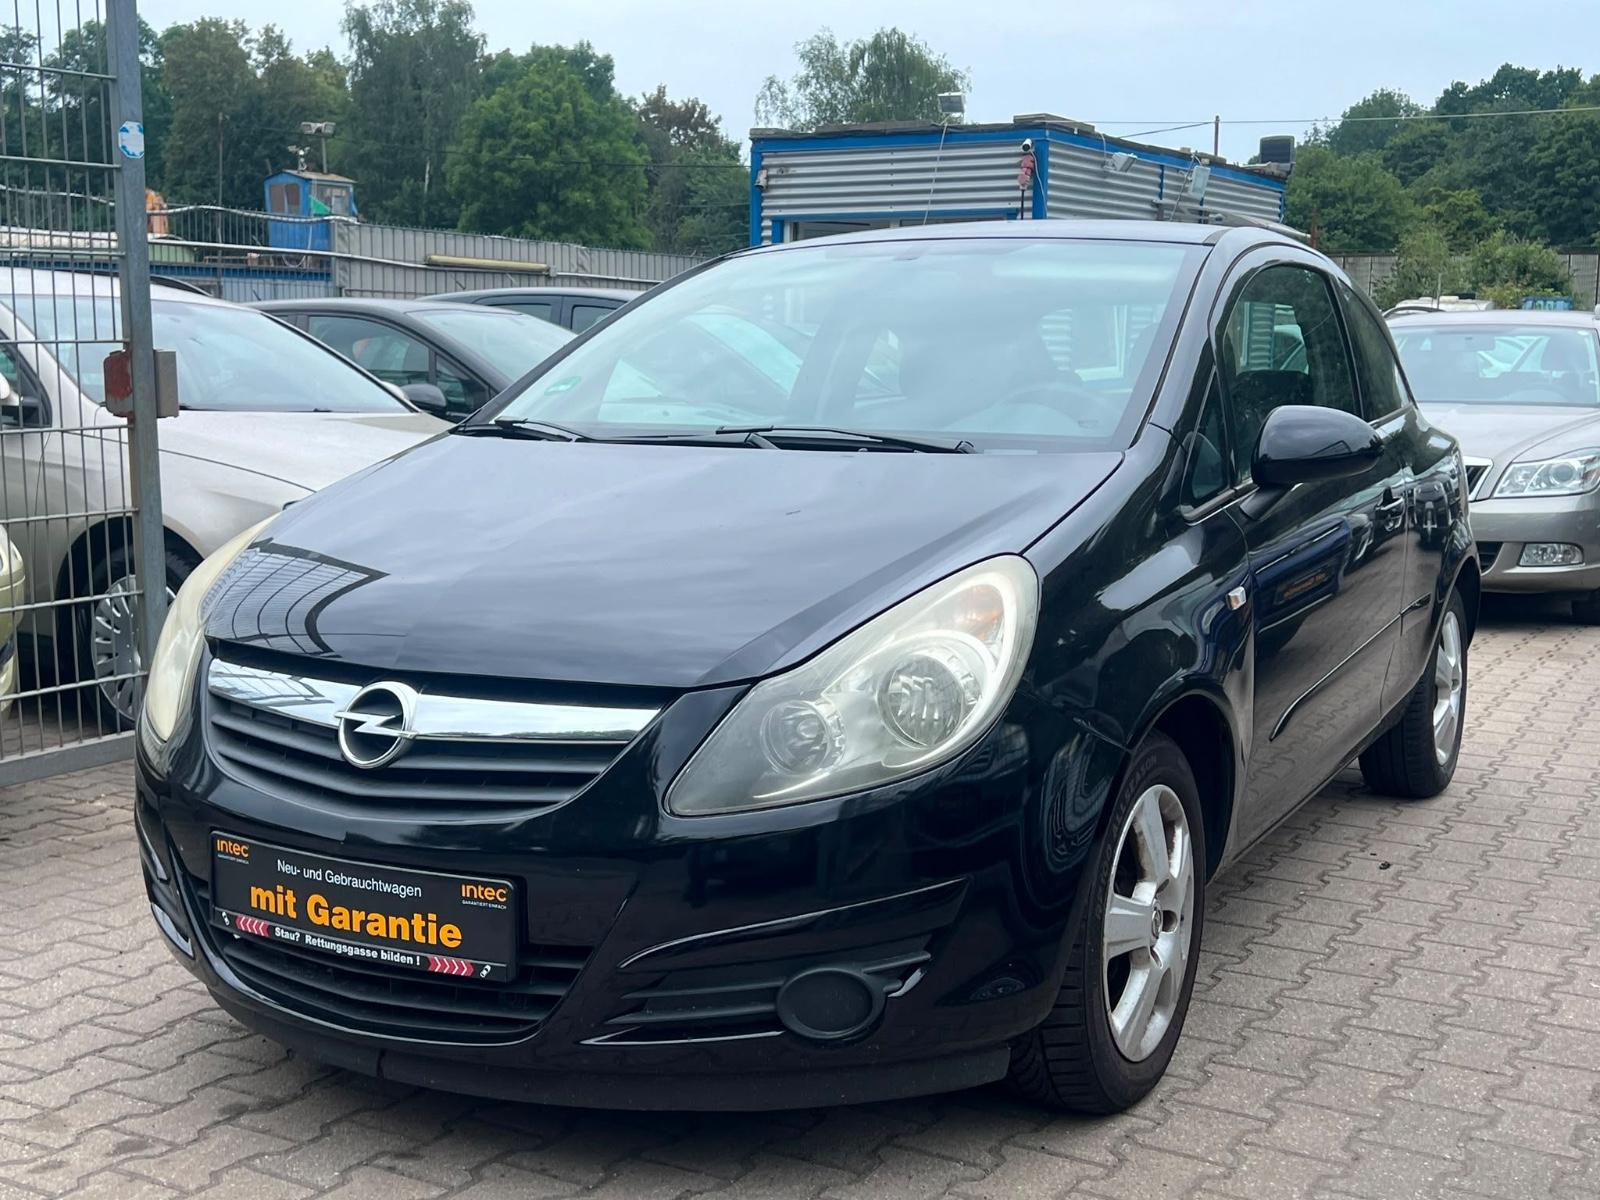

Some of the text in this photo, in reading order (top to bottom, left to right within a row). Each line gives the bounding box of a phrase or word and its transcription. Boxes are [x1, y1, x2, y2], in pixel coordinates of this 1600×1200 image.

[277, 859, 422, 899] Neu- und Gebrauchtwagen
[250, 884, 462, 948] mit Garantie
[274, 927, 301, 942] Stau?
[305, 934, 378, 958] Rettungsgasse
[380, 949, 413, 966] bilden
